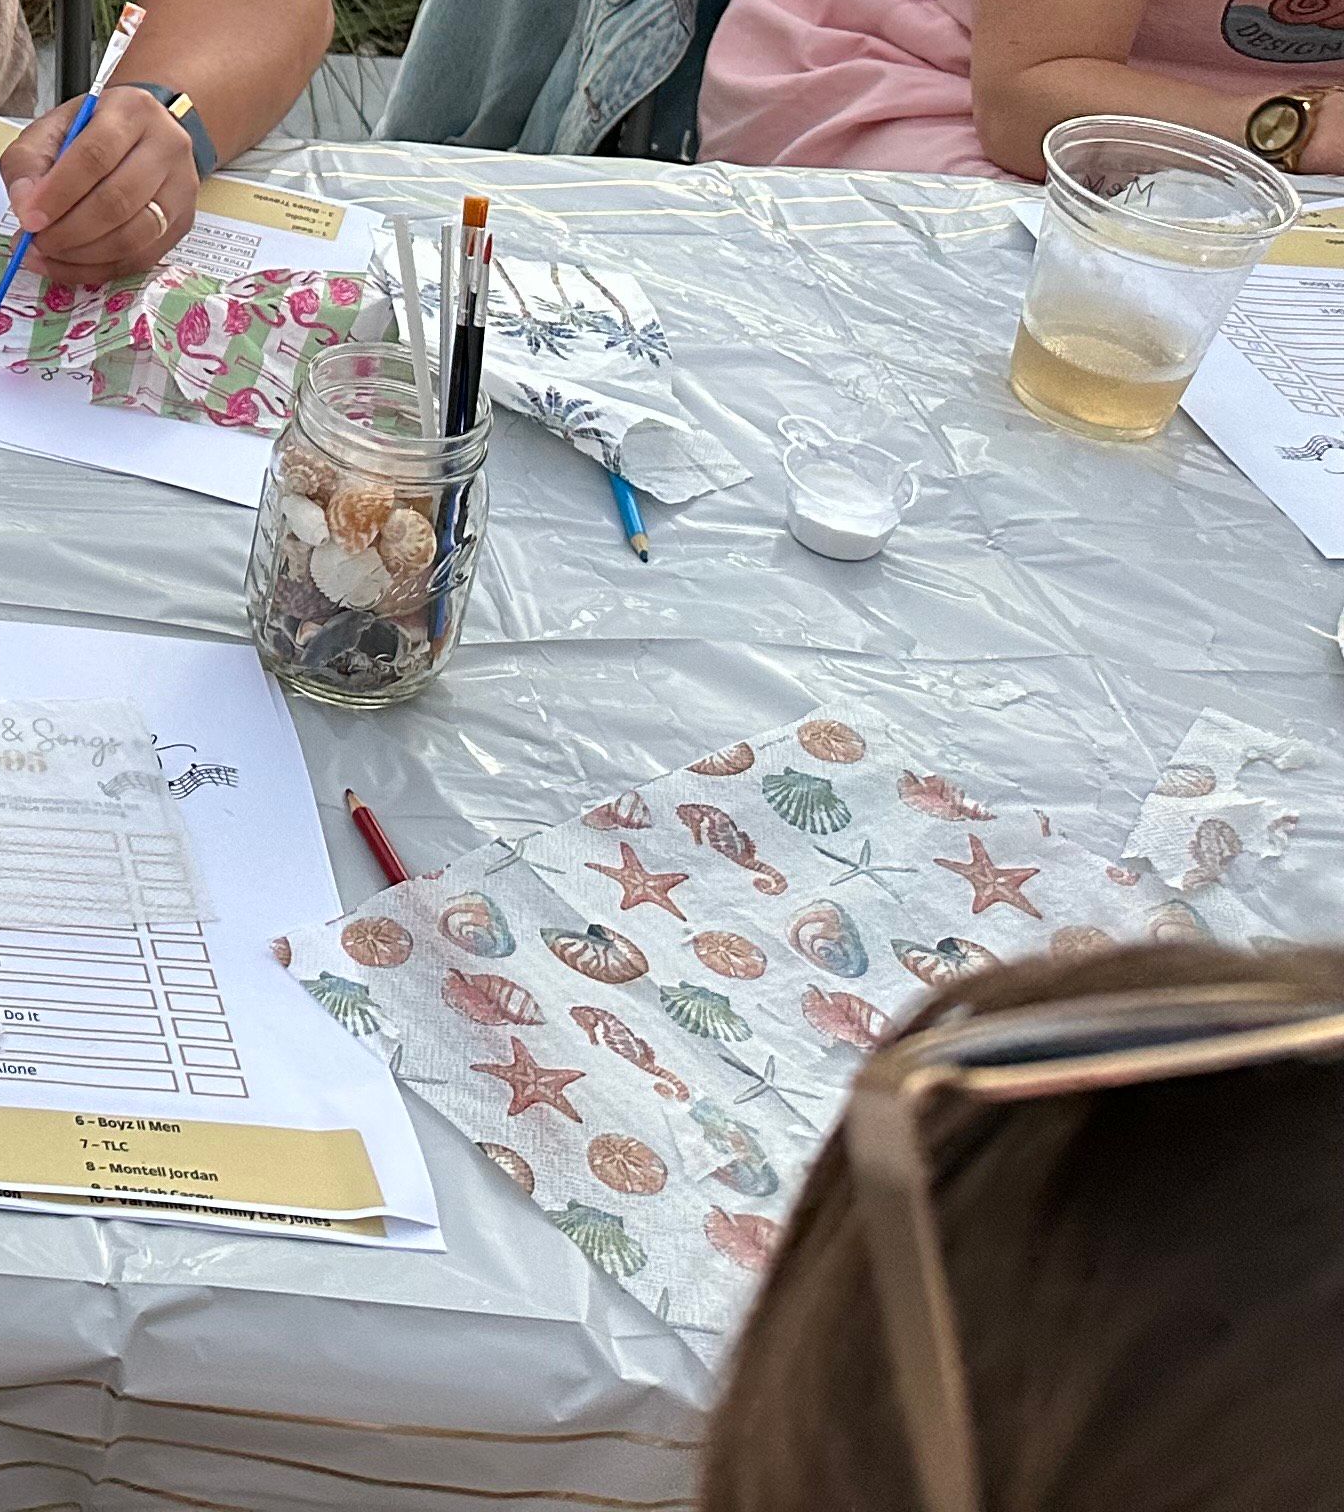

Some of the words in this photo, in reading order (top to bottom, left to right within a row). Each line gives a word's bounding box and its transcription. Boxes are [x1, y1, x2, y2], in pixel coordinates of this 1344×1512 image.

[1, 717, 24, 743] &
[32, 718, 122, 767] Songs
[5, 1009, 24, 1021] Do
[28, 1010, 40, 1022] It
[75, 1115, 84, 1126] 6
[97, 1117, 134, 1131] Boyz
[148, 1121, 181, 1133] Men
[79, 1138, 88, 1149] 7
[101, 1140, 130, 1152] TLC
[86, 1161, 96, 1172] 8
[109, 1163, 166, 1178] Montell
[168, 1168, 219, 1182] Jordan
[288, 1213, 332, 1228] Jones
